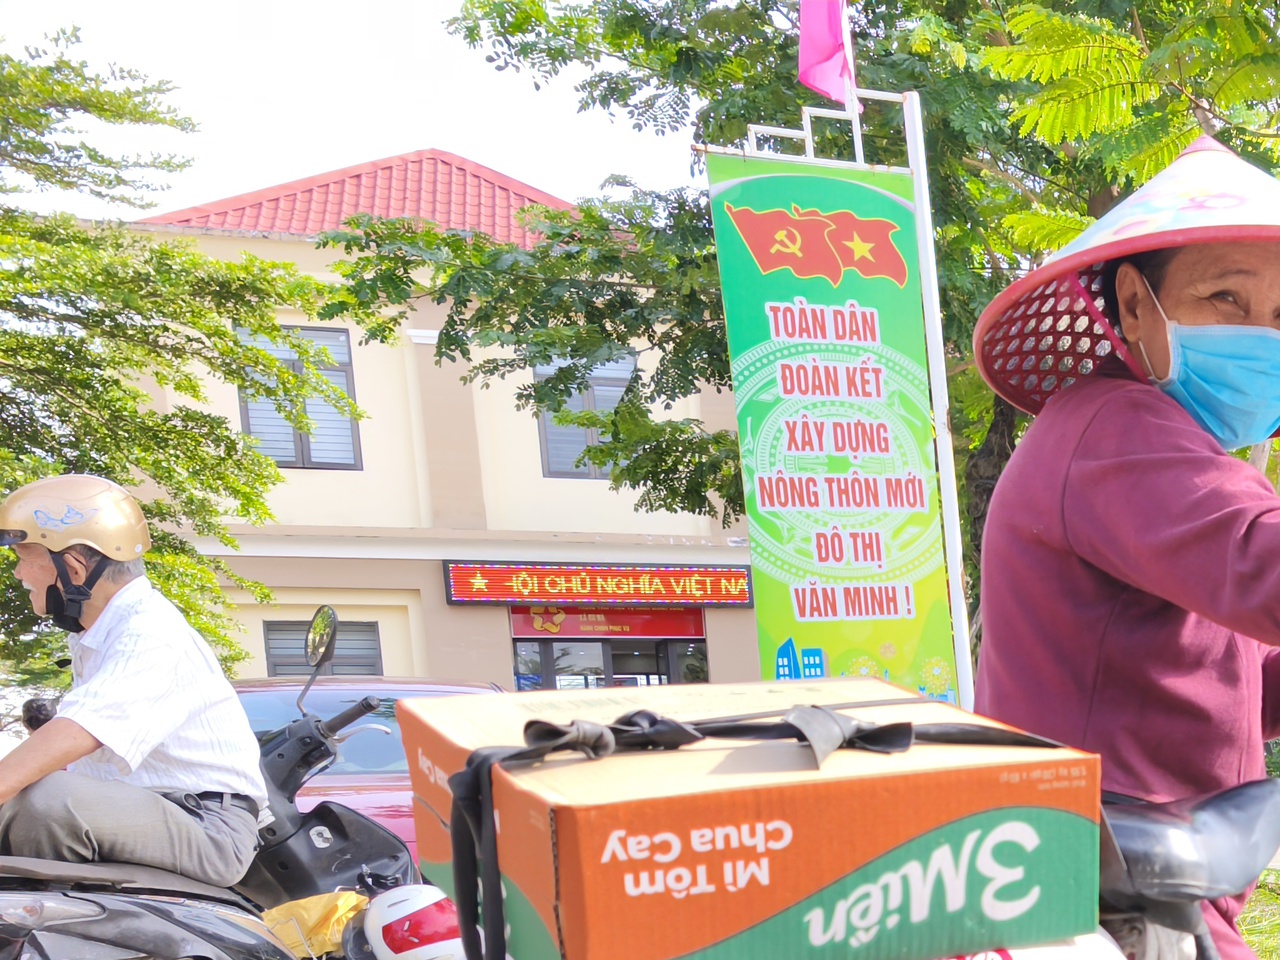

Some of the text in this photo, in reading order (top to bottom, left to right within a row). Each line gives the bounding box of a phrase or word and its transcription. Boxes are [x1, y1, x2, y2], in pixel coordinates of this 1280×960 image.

[769, 301, 877, 342] TOÀN DÂN
[780, 357, 882, 398] ĐOÀN KẾT
[784, 414, 889, 459] XÂY DỰNG
[758, 469, 925, 509] NÔNG THÔN MỚI
[815, 526, 882, 569] ĐÔ THỊ
[544, 572, 591, 594] CHỦ
[597, 574, 665, 594] NGHĨA
[670, 574, 715, 597] VIỆT
[794, 580, 837, 618] VĂN
[843, 586, 898, 617] MINH
[601, 820, 793, 863] Chua Cay
[624, 857, 770, 899] Mì Tôm
